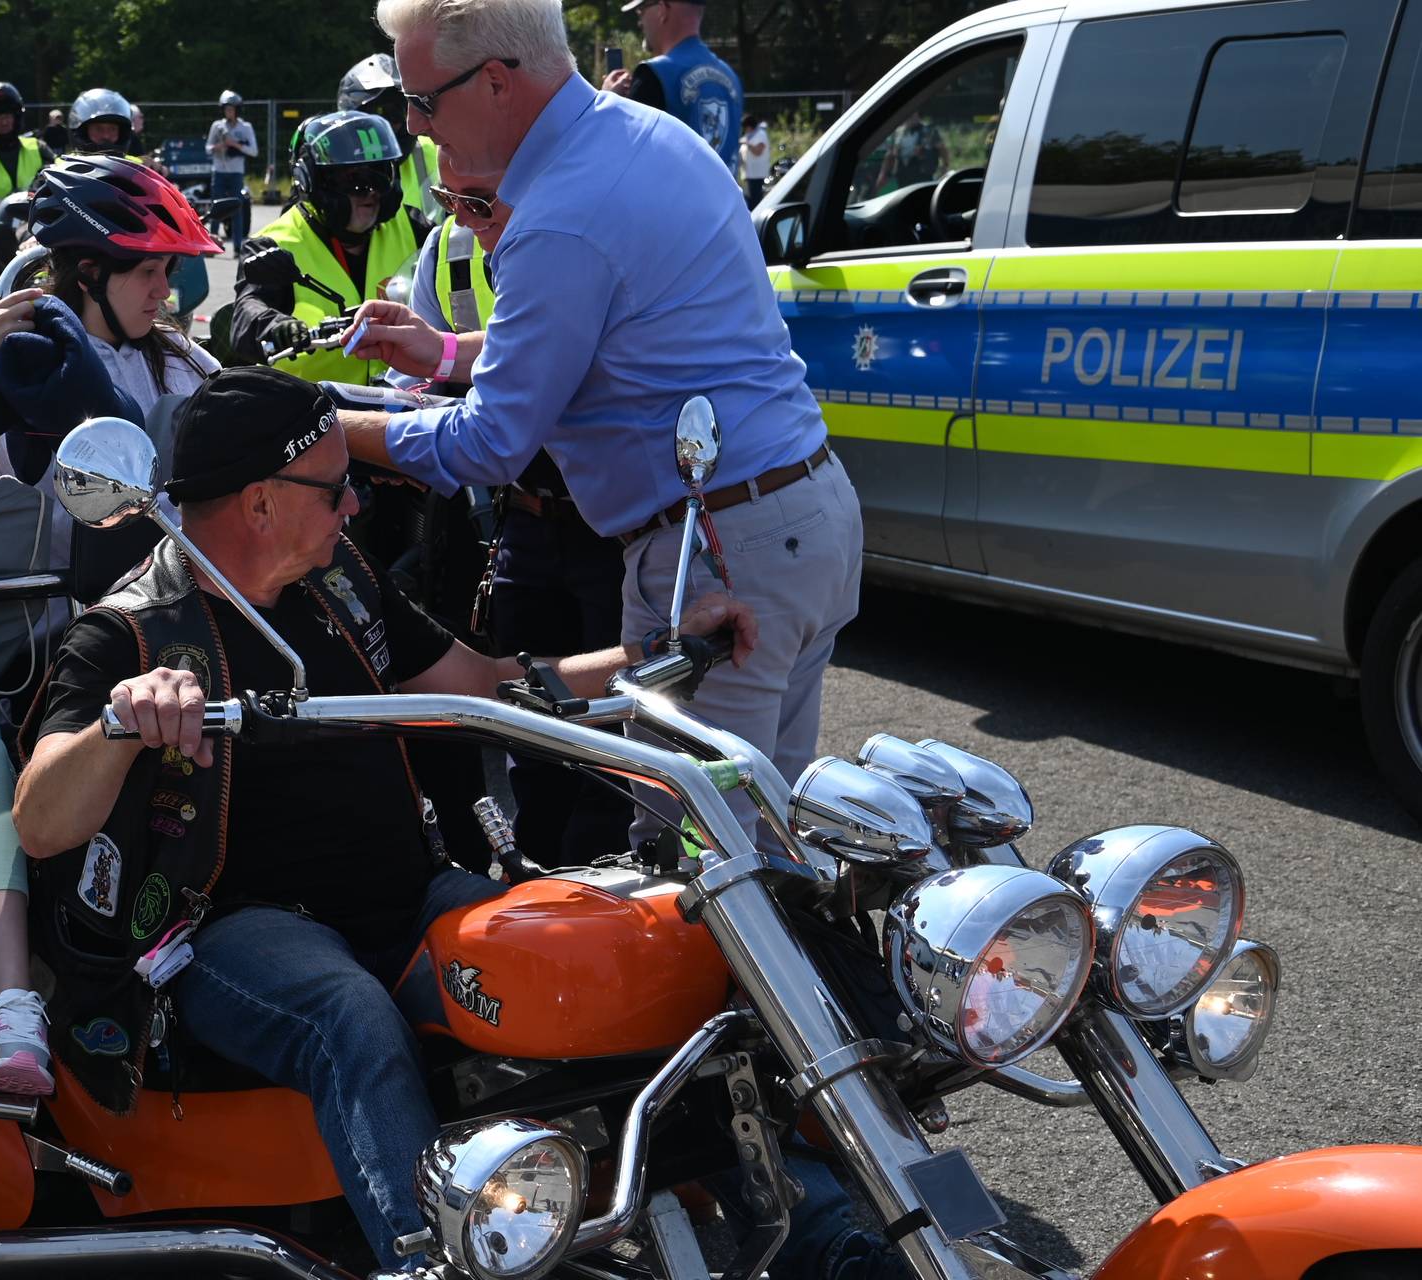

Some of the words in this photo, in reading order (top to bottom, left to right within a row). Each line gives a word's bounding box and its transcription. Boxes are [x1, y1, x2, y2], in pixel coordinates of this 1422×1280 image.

[62, 196, 110, 235] ROCKRIDER
[1040, 327, 1244, 391] POLIZEI
[284, 429, 318, 463] Free
